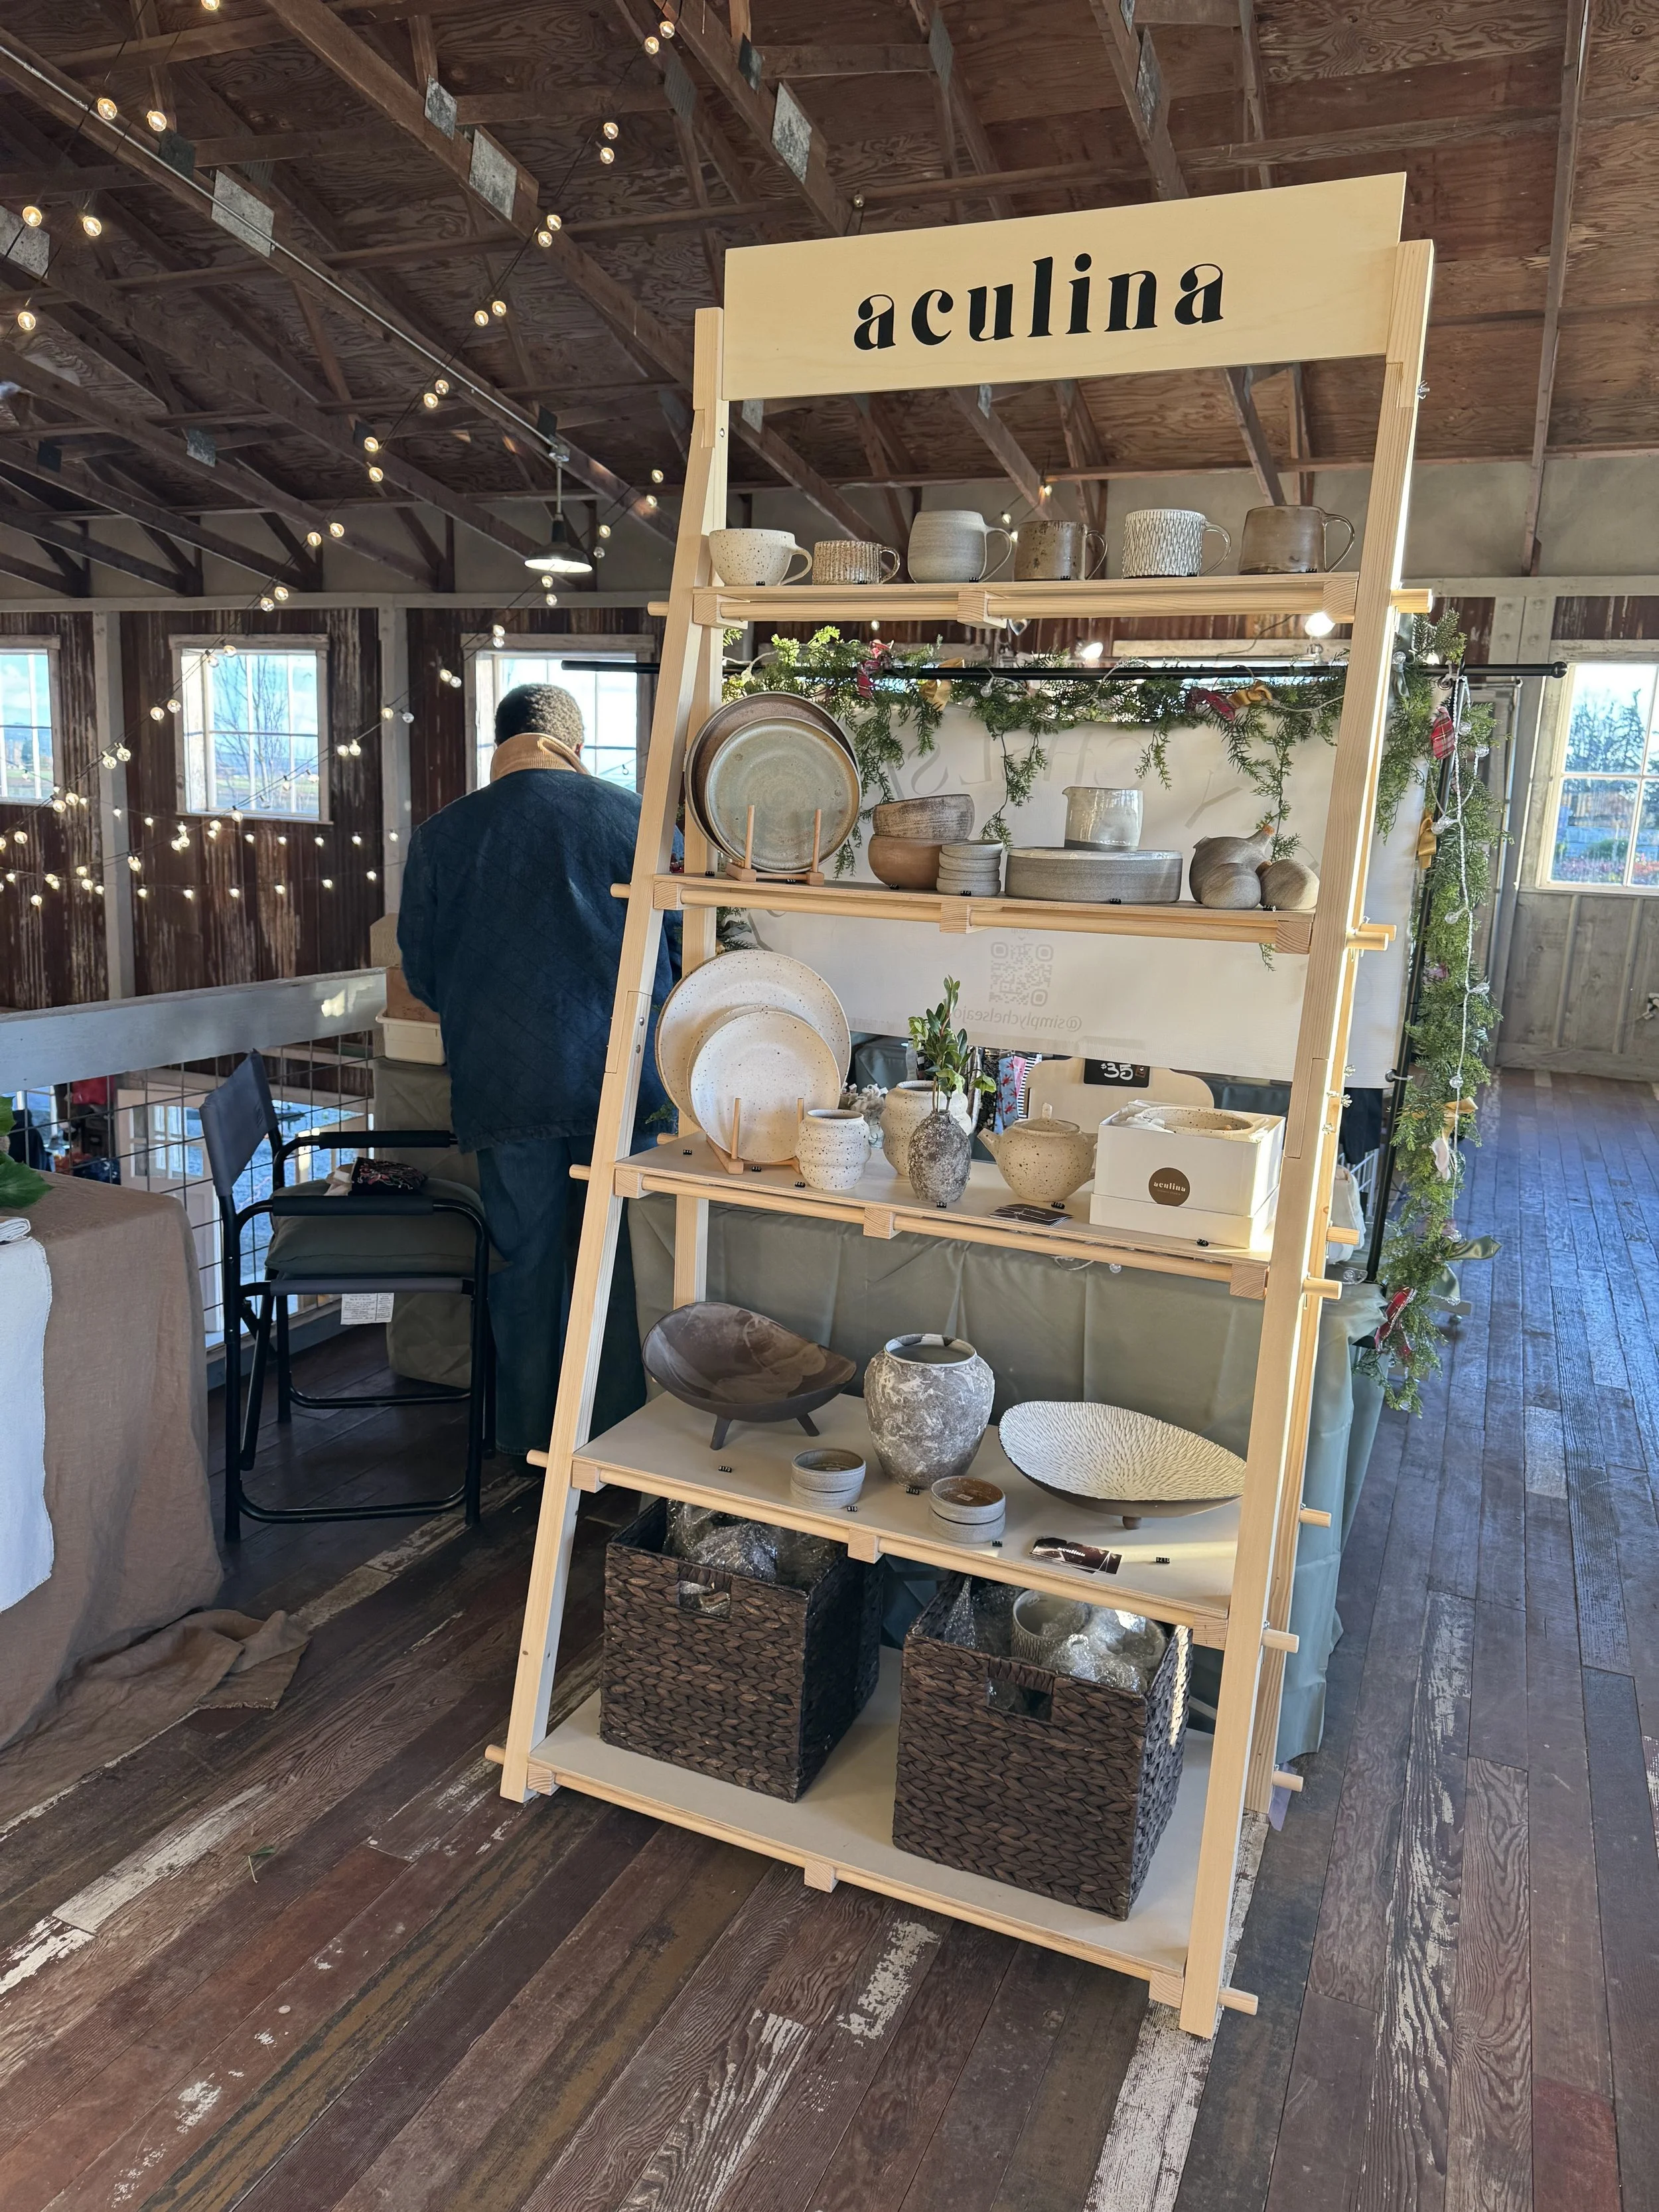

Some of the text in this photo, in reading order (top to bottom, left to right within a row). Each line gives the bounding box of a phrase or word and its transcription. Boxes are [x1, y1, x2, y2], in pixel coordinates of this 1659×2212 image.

[853, 253, 1224, 351] aculina
[1100, 1062, 1133, 1080] $35
[1153, 1181, 1186, 1192] aculina
